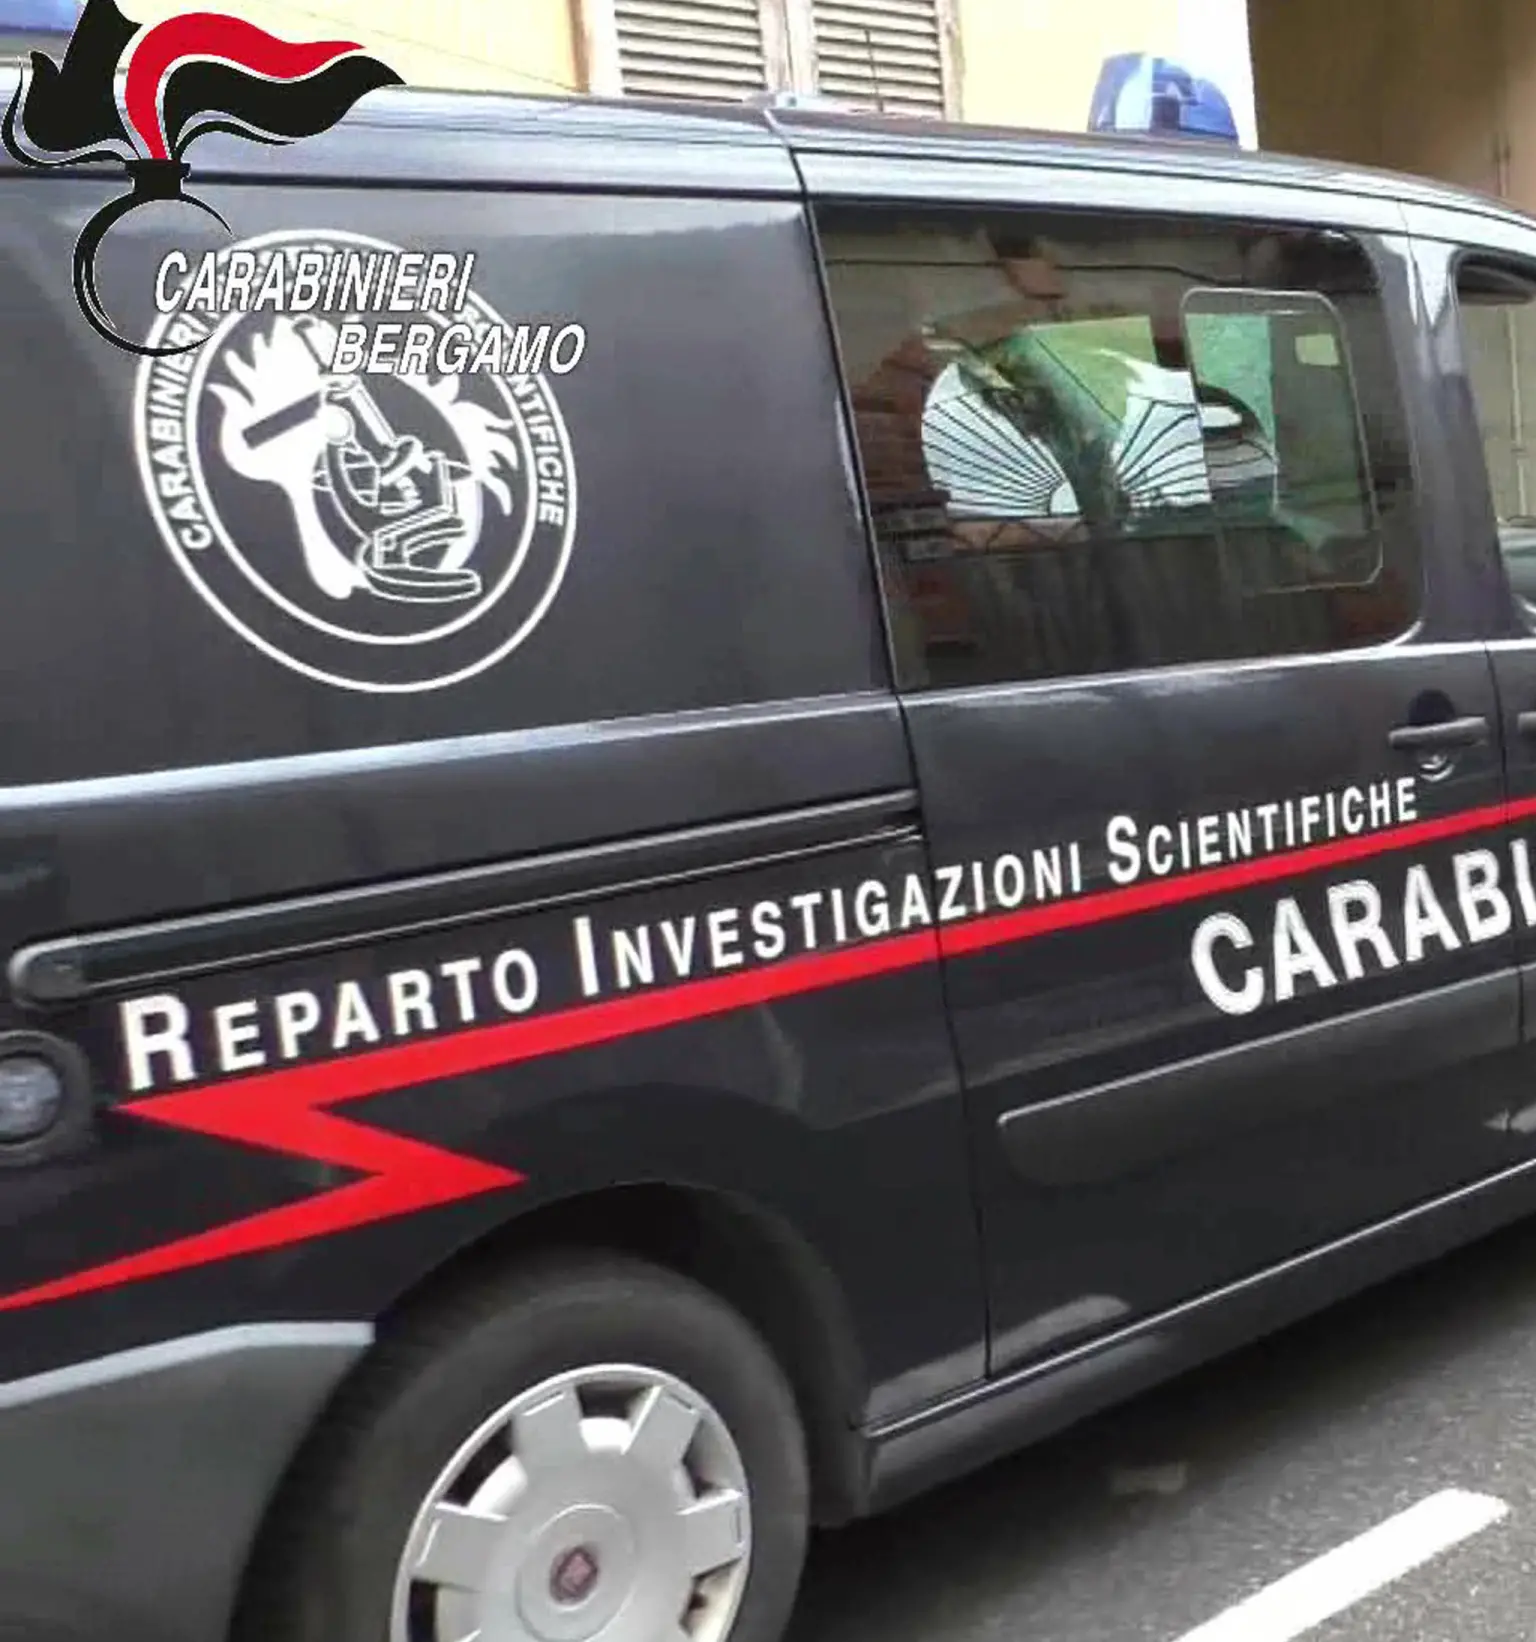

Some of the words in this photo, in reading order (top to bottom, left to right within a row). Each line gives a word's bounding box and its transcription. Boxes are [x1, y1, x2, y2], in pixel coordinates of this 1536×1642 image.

[120, 948, 539, 1092] REPARTO
[572, 841, 1082, 998] INVESTIGAZIONI
[1105, 776, 1418, 885] SCIENTIFICHE
